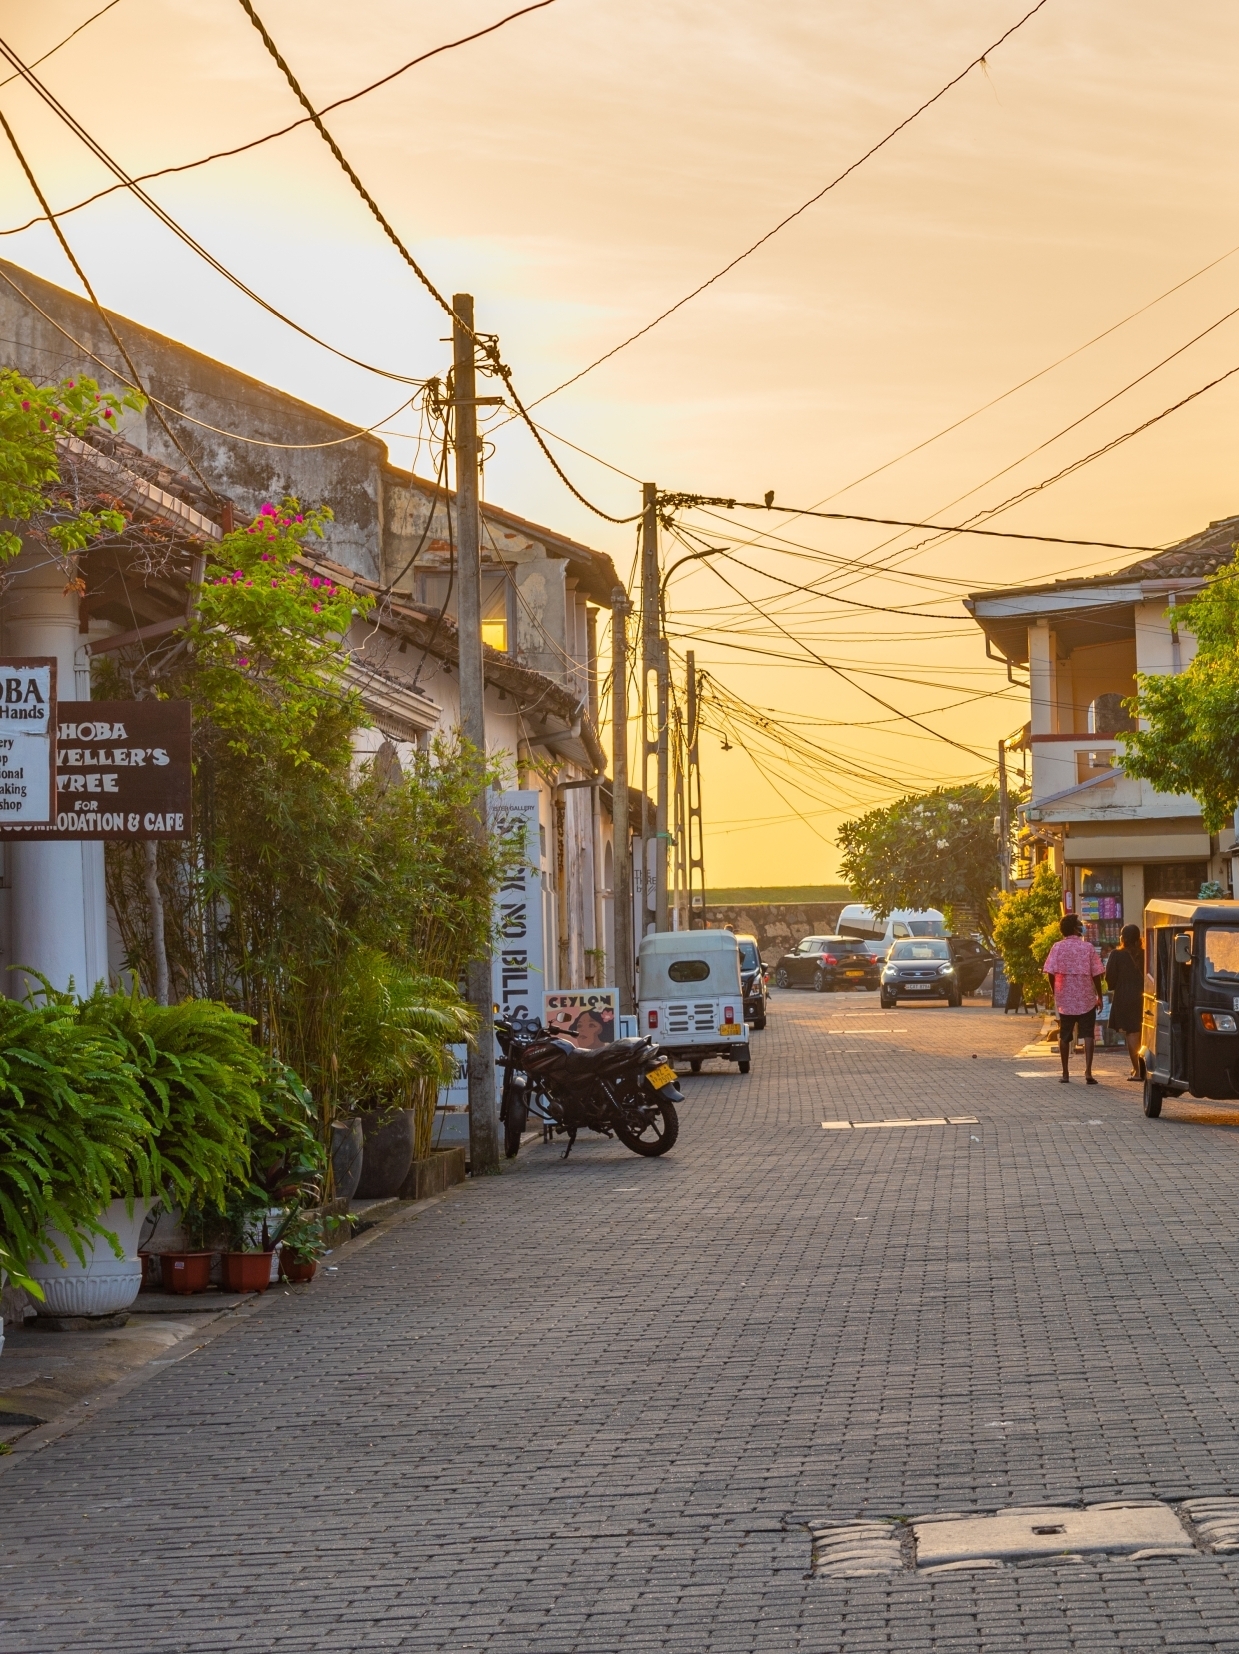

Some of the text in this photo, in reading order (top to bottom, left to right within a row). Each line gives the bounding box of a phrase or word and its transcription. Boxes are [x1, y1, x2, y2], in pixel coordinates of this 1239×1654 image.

[0, 678, 45, 704] BA
[57, 773, 119, 793] TREE
[74, 801, 98, 811] FOR
[127, 812, 140, 832] &
[144, 812, 184, 832] CAFE
[500, 903, 528, 939] NO
[501, 949, 529, 1020] BILLS
[548, 995, 612, 1008] CEYLON
